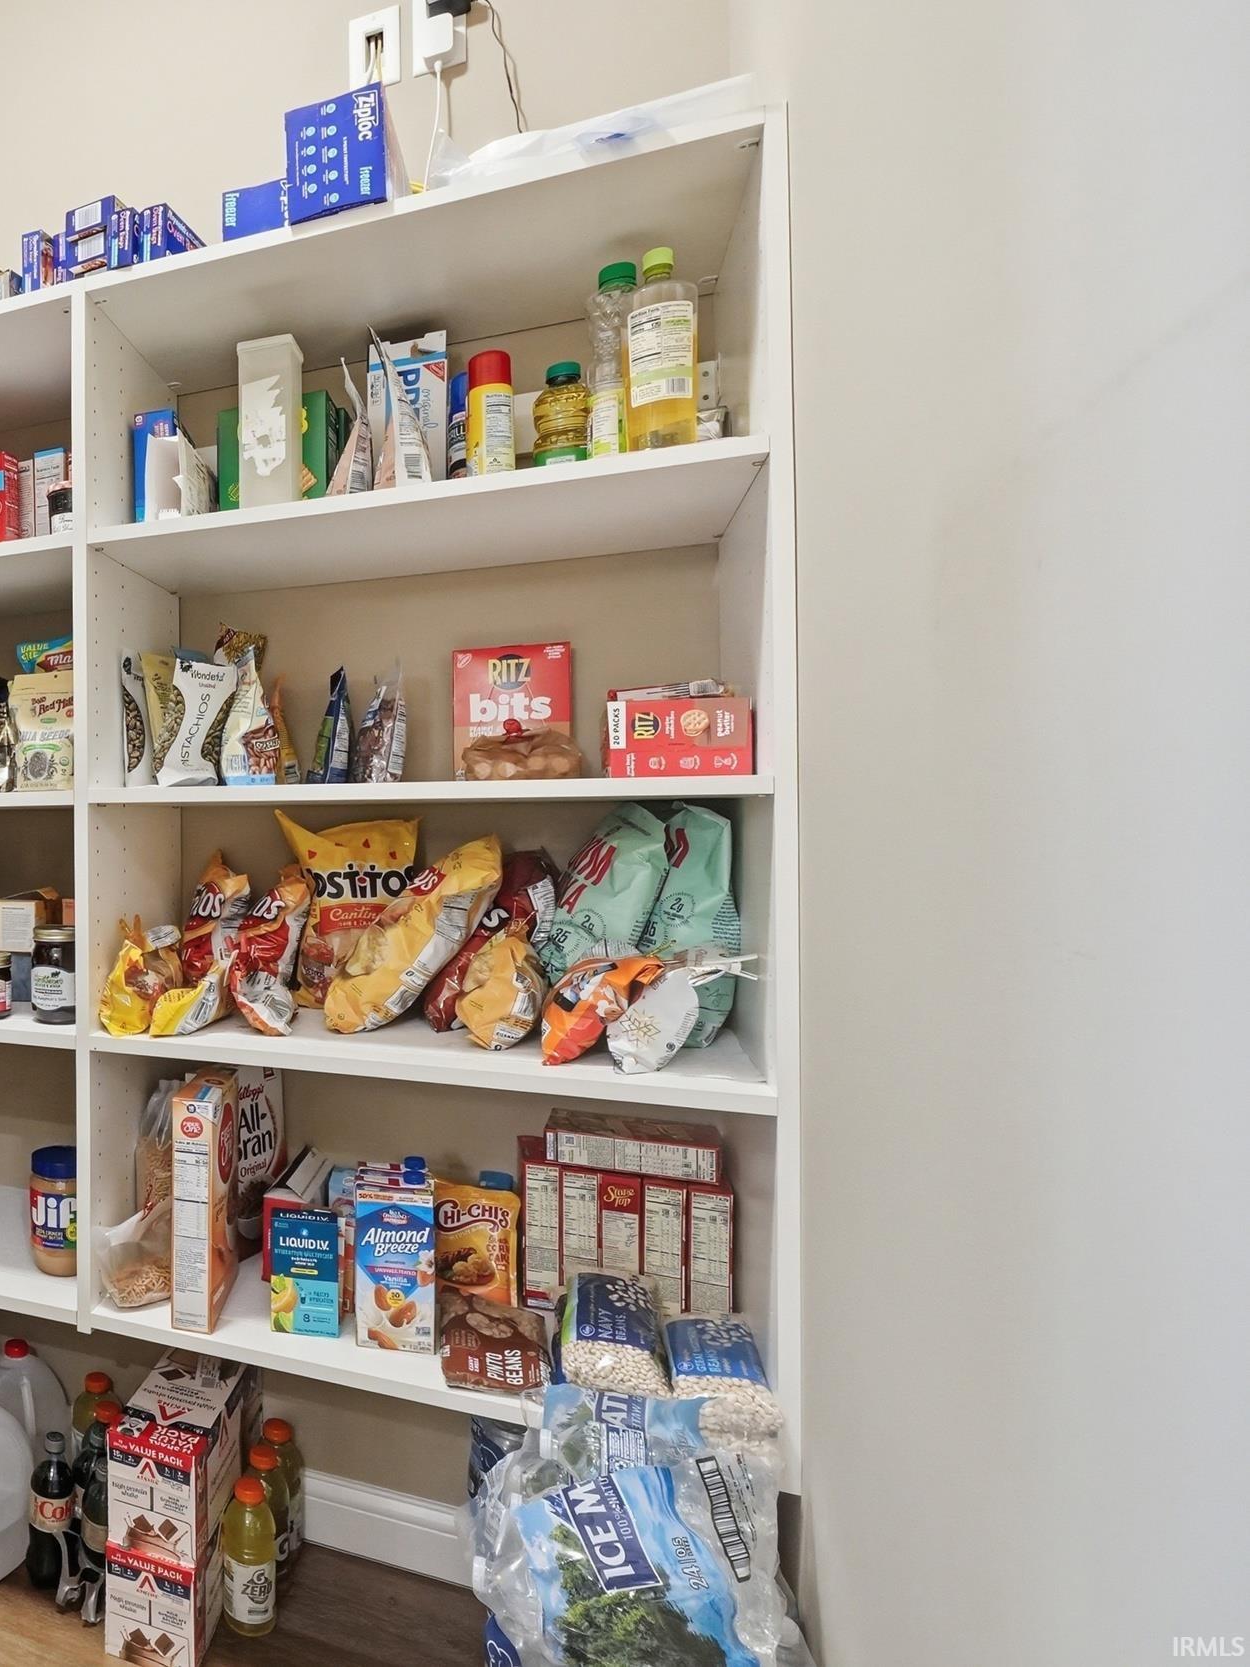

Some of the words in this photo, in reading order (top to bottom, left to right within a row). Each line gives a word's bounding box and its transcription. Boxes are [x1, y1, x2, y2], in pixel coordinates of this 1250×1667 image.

[353, 93, 376, 142] Ziploc
[20, 642, 50, 653] VALUE
[488, 658, 531, 686] RITZ
[38, 701, 56, 717] Red
[469, 692, 552, 723] bits
[612, 707, 620, 733] PACKS
[634, 711, 655, 740] RITZ
[612, 734, 620, 746] 20
[311, 863, 416, 899] OSTITOS
[328, 905, 381, 922] Cantin
[669, 896, 685, 914] 2g
[239, 1102, 268, 1135] All-
[239, 1158, 267, 1178] Original
[358, 1192, 374, 1200] 50%
[603, 1185, 636, 1203] Stove
[614, 1195, 631, 1208] Top
[280, 1212, 317, 1220] LIQUID
[435, 1199, 511, 1230] CHI-CHI'S
[279, 1236, 317, 1250] LIQUID
[317, 1240, 330, 1251] I.V.
[361, 1227, 430, 1246] Almond
[374, 1242, 420, 1257] Breeze
[302, 1313, 311, 1323] 8
[597, 1308, 613, 1340] NAVY
[615, 1313, 627, 1341] BEANS
[485, 1351, 504, 1382] PINTO
[503, 1349, 525, 1386] BEANS
[129, 1442, 157, 1459] VALUE
[157, 1450, 184, 1468] PACK
[600, 1475, 619, 1508] NATU
[38, 1500, 73, 1521] Cok
[613, 1506, 634, 1541] 100%
[583, 1520, 636, 1580] ICE
[126, 1556, 157, 1573] VALUE
[157, 1564, 183, 1583] PACK
[252, 1568, 266, 1584] G
[681, 1564, 710, 1592] 24
[240, 1581, 273, 1598] ZERO
